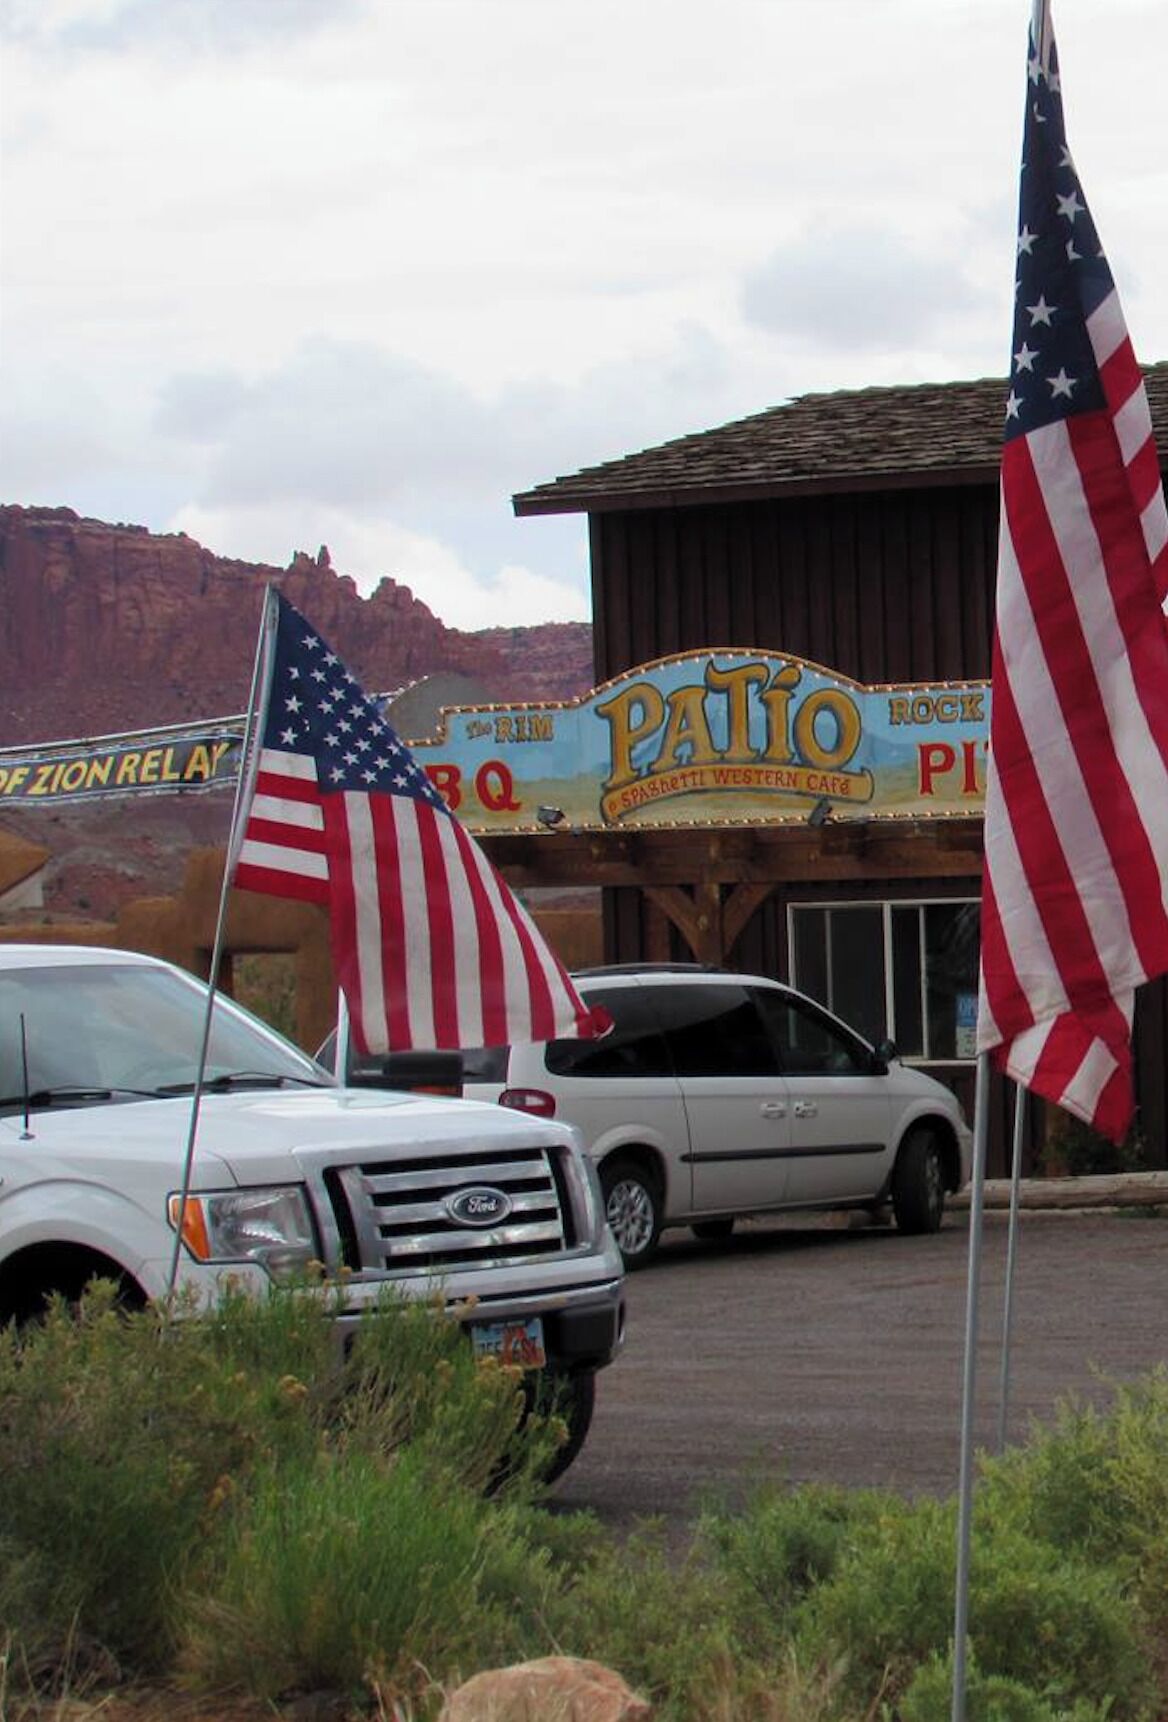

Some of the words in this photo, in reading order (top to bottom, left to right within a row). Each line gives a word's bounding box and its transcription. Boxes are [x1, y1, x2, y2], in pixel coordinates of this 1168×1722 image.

[889, 693, 985, 725] ROCK
[495, 714, 554, 743] RIM
[27, 756, 114, 796] ZION
[116, 742, 231, 785] RELAY
[713, 767, 798, 788] WESTERN
[918, 740, 989, 796] PI
[467, 1194, 498, 1214] Ford
